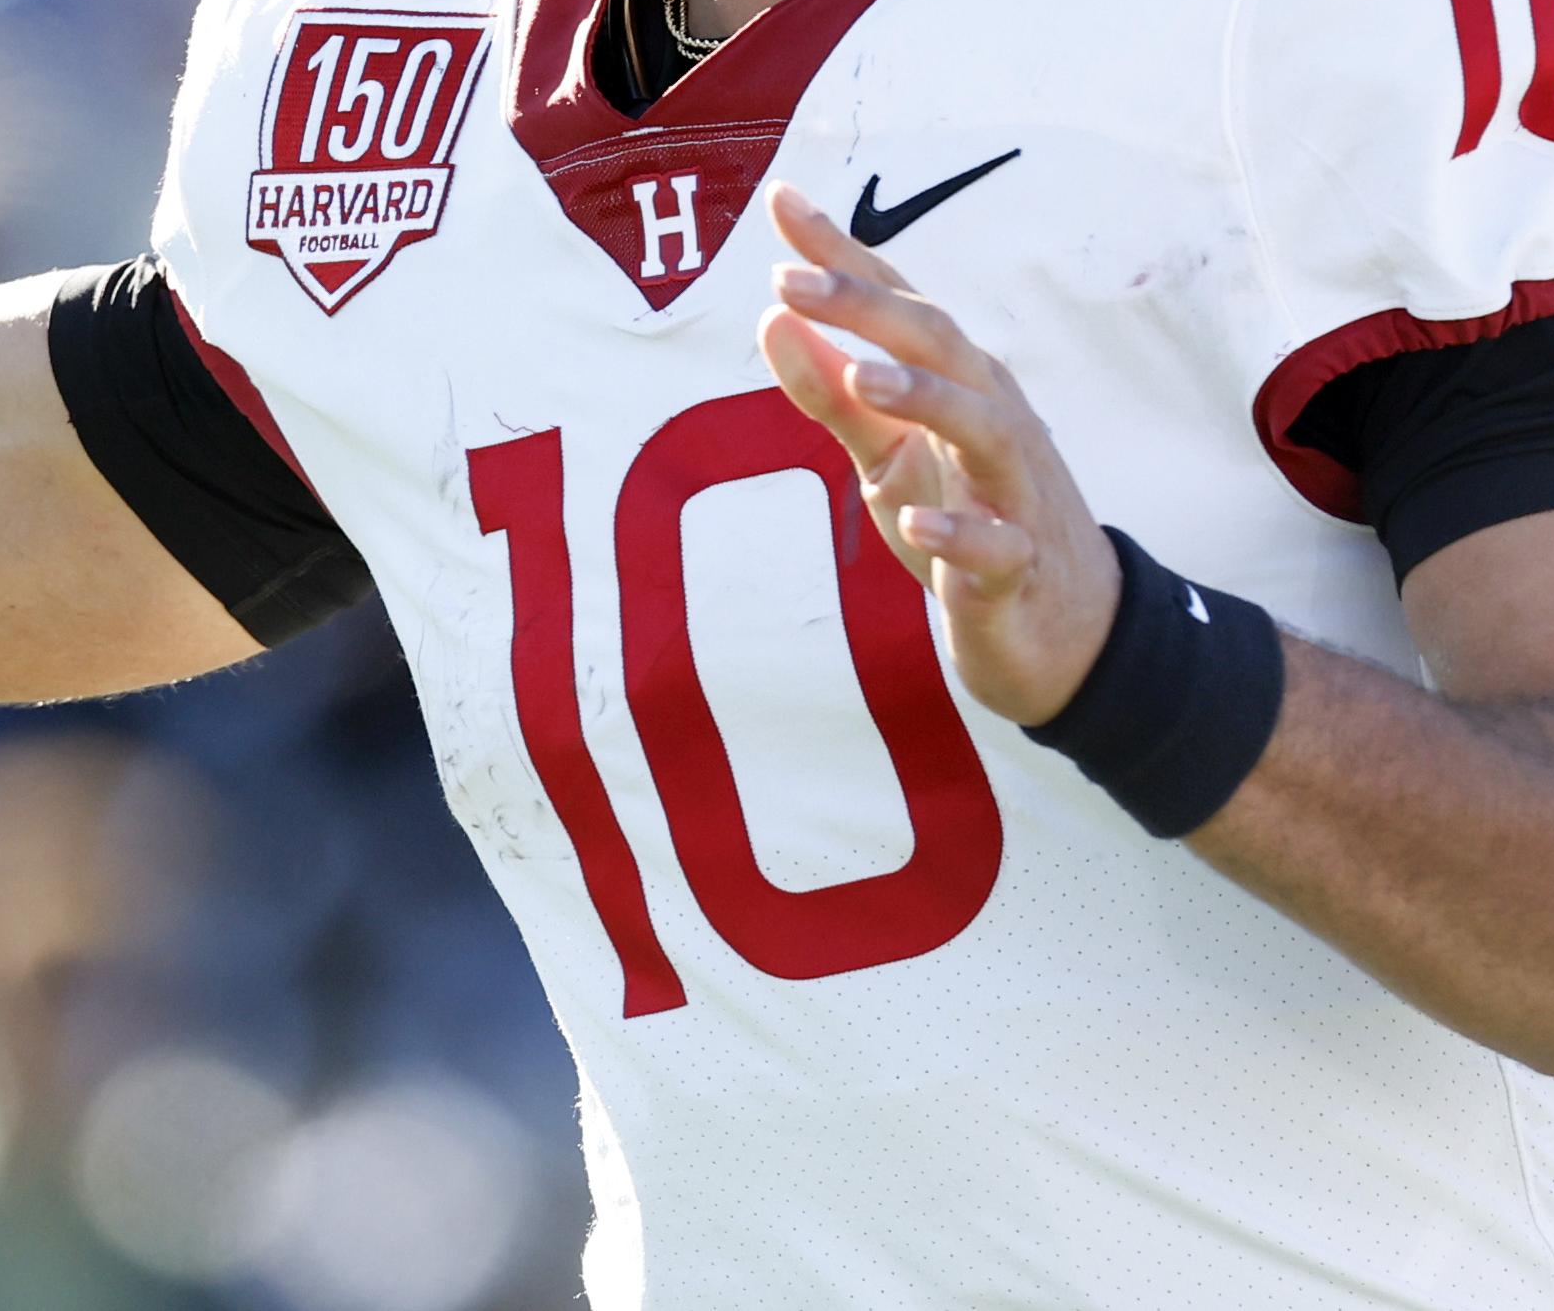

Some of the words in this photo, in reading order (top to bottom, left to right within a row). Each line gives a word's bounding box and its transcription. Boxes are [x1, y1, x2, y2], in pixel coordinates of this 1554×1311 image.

[298, 34, 454, 164] 150
[255, 178, 434, 230] HARVARD
[297, 231, 381, 255] FOOTBALL
[632, 173, 706, 279] H
[466, 385, 1004, 1020] 10
